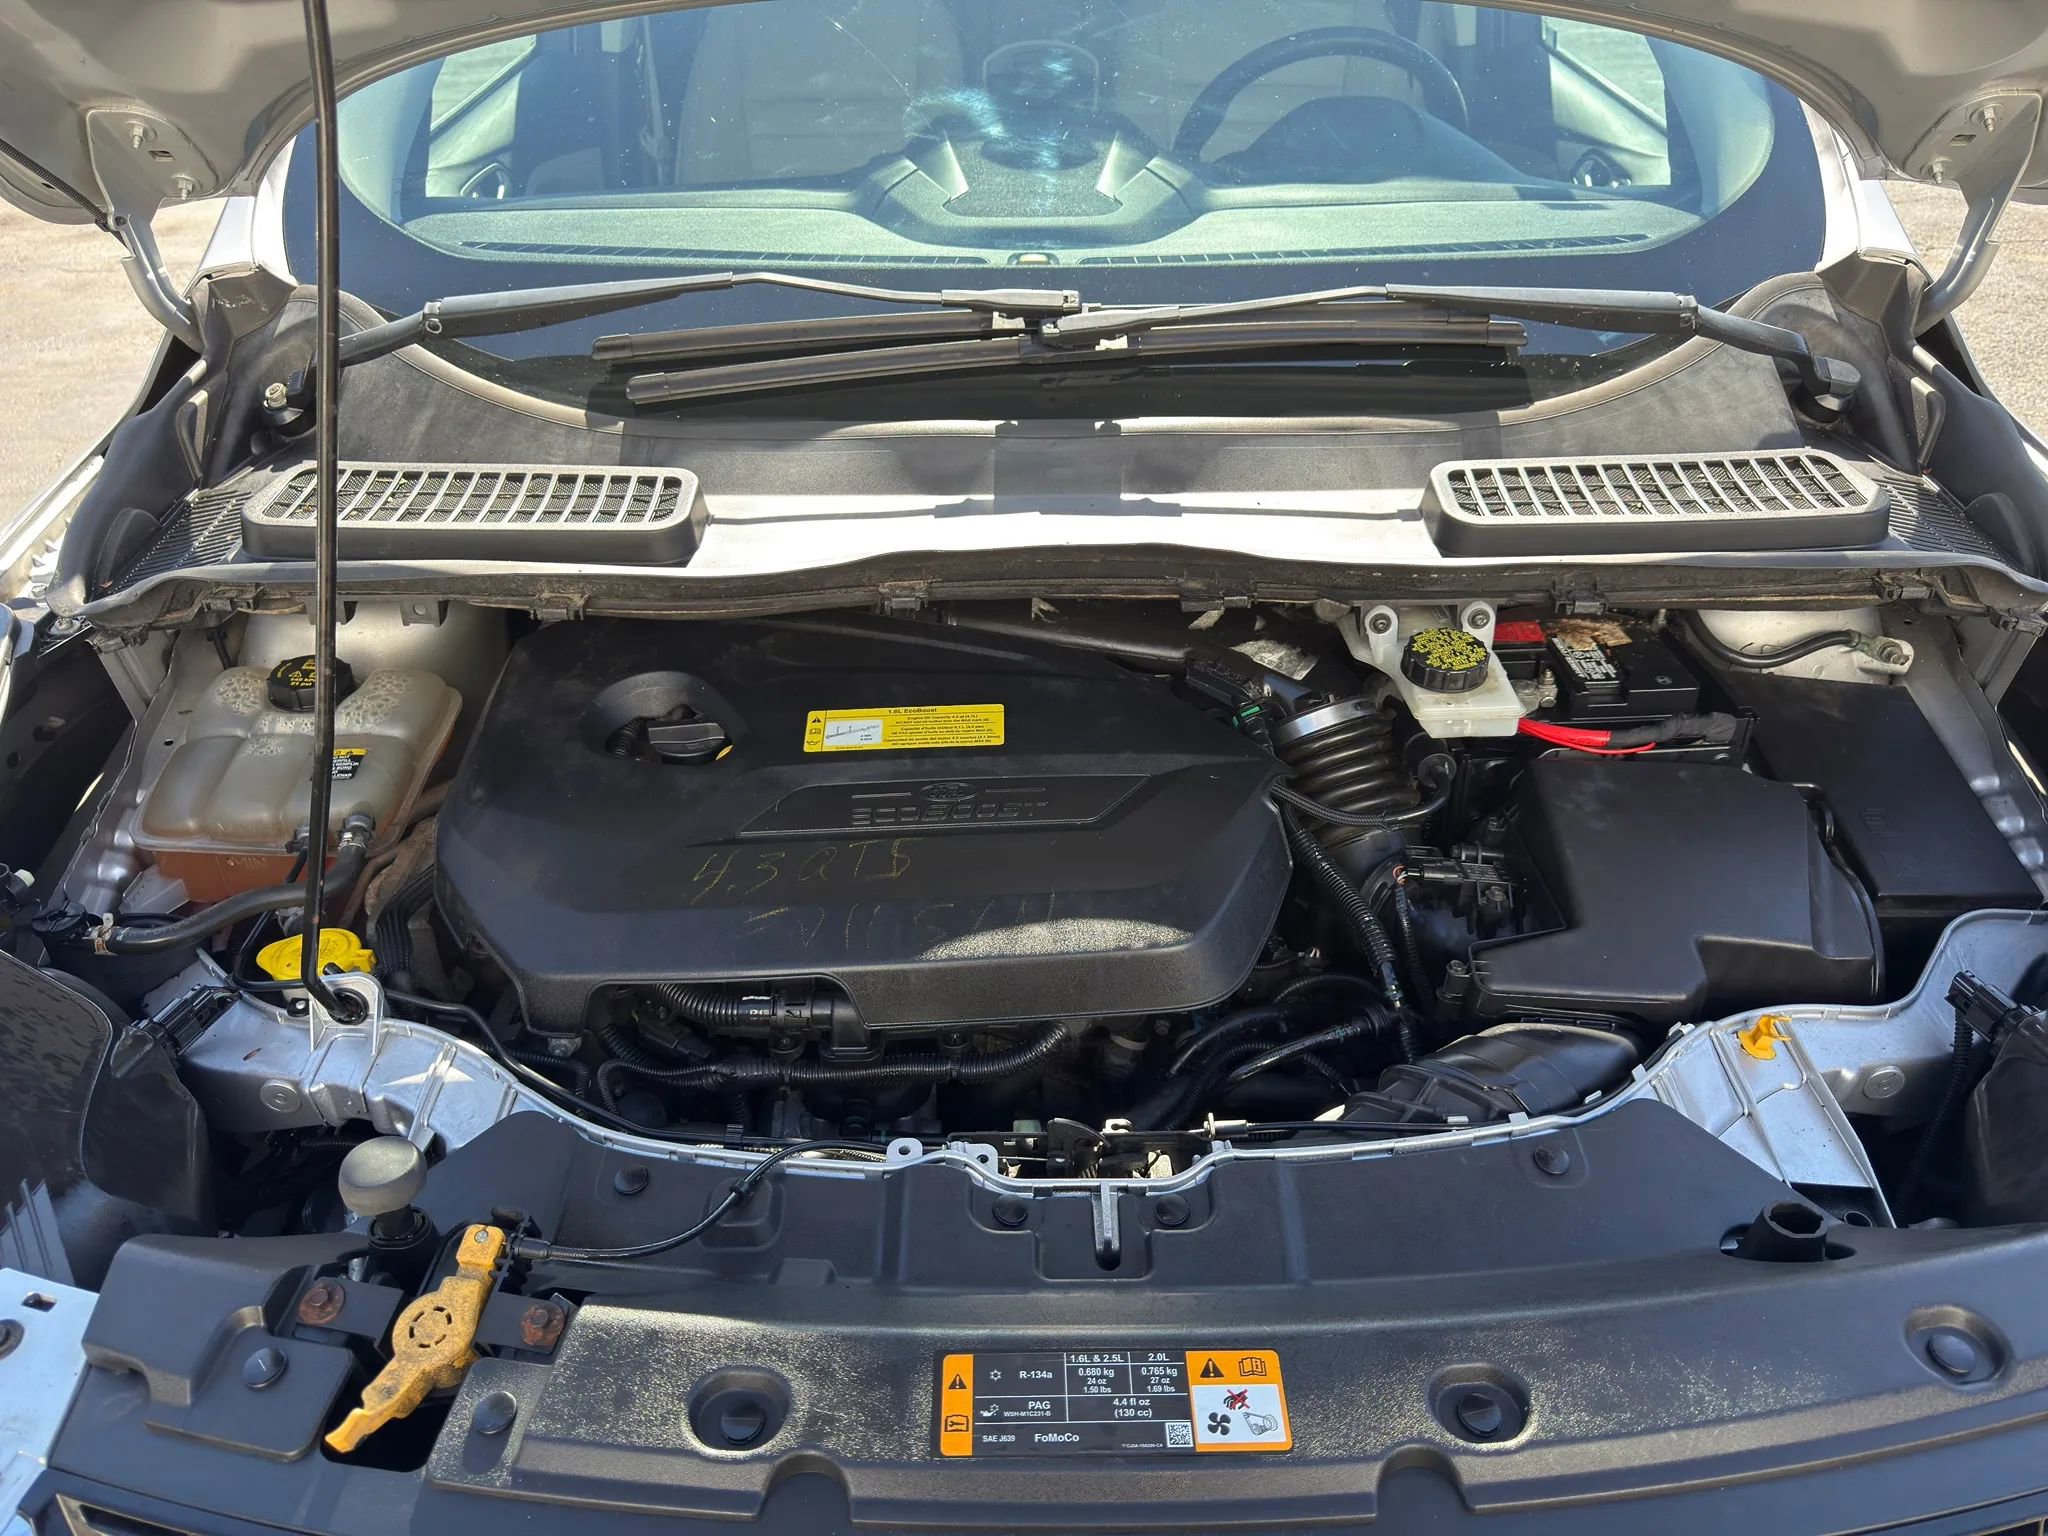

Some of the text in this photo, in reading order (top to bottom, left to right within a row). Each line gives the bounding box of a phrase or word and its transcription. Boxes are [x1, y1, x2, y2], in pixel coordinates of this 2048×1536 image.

[852, 801, 1048, 825] ECOBOOST
[1070, 1354, 1125, 1363] 1.6L & 2.5L
[1148, 1353, 1170, 1361] 2.0L
[1019, 1370, 1053, 1379] R-134a
[1078, 1367, 1115, 1378] 0.680 kg
[1141, 1366, 1178, 1377] 0.765 kg
[1087, 1377, 1096, 1385] 24
[1084, 1386, 1099, 1394] 1.50
[1147, 1385, 1175, 1393] 1.69 lbs
[1028, 1401, 1051, 1410] PAG
[1113, 1398, 1129, 1406] 4.4
[1130, 1398, 1136, 1406] fl
[1114, 1408, 1153, 1418] (130 cc)
[1034, 1433, 1080, 1443] FoMoCo
